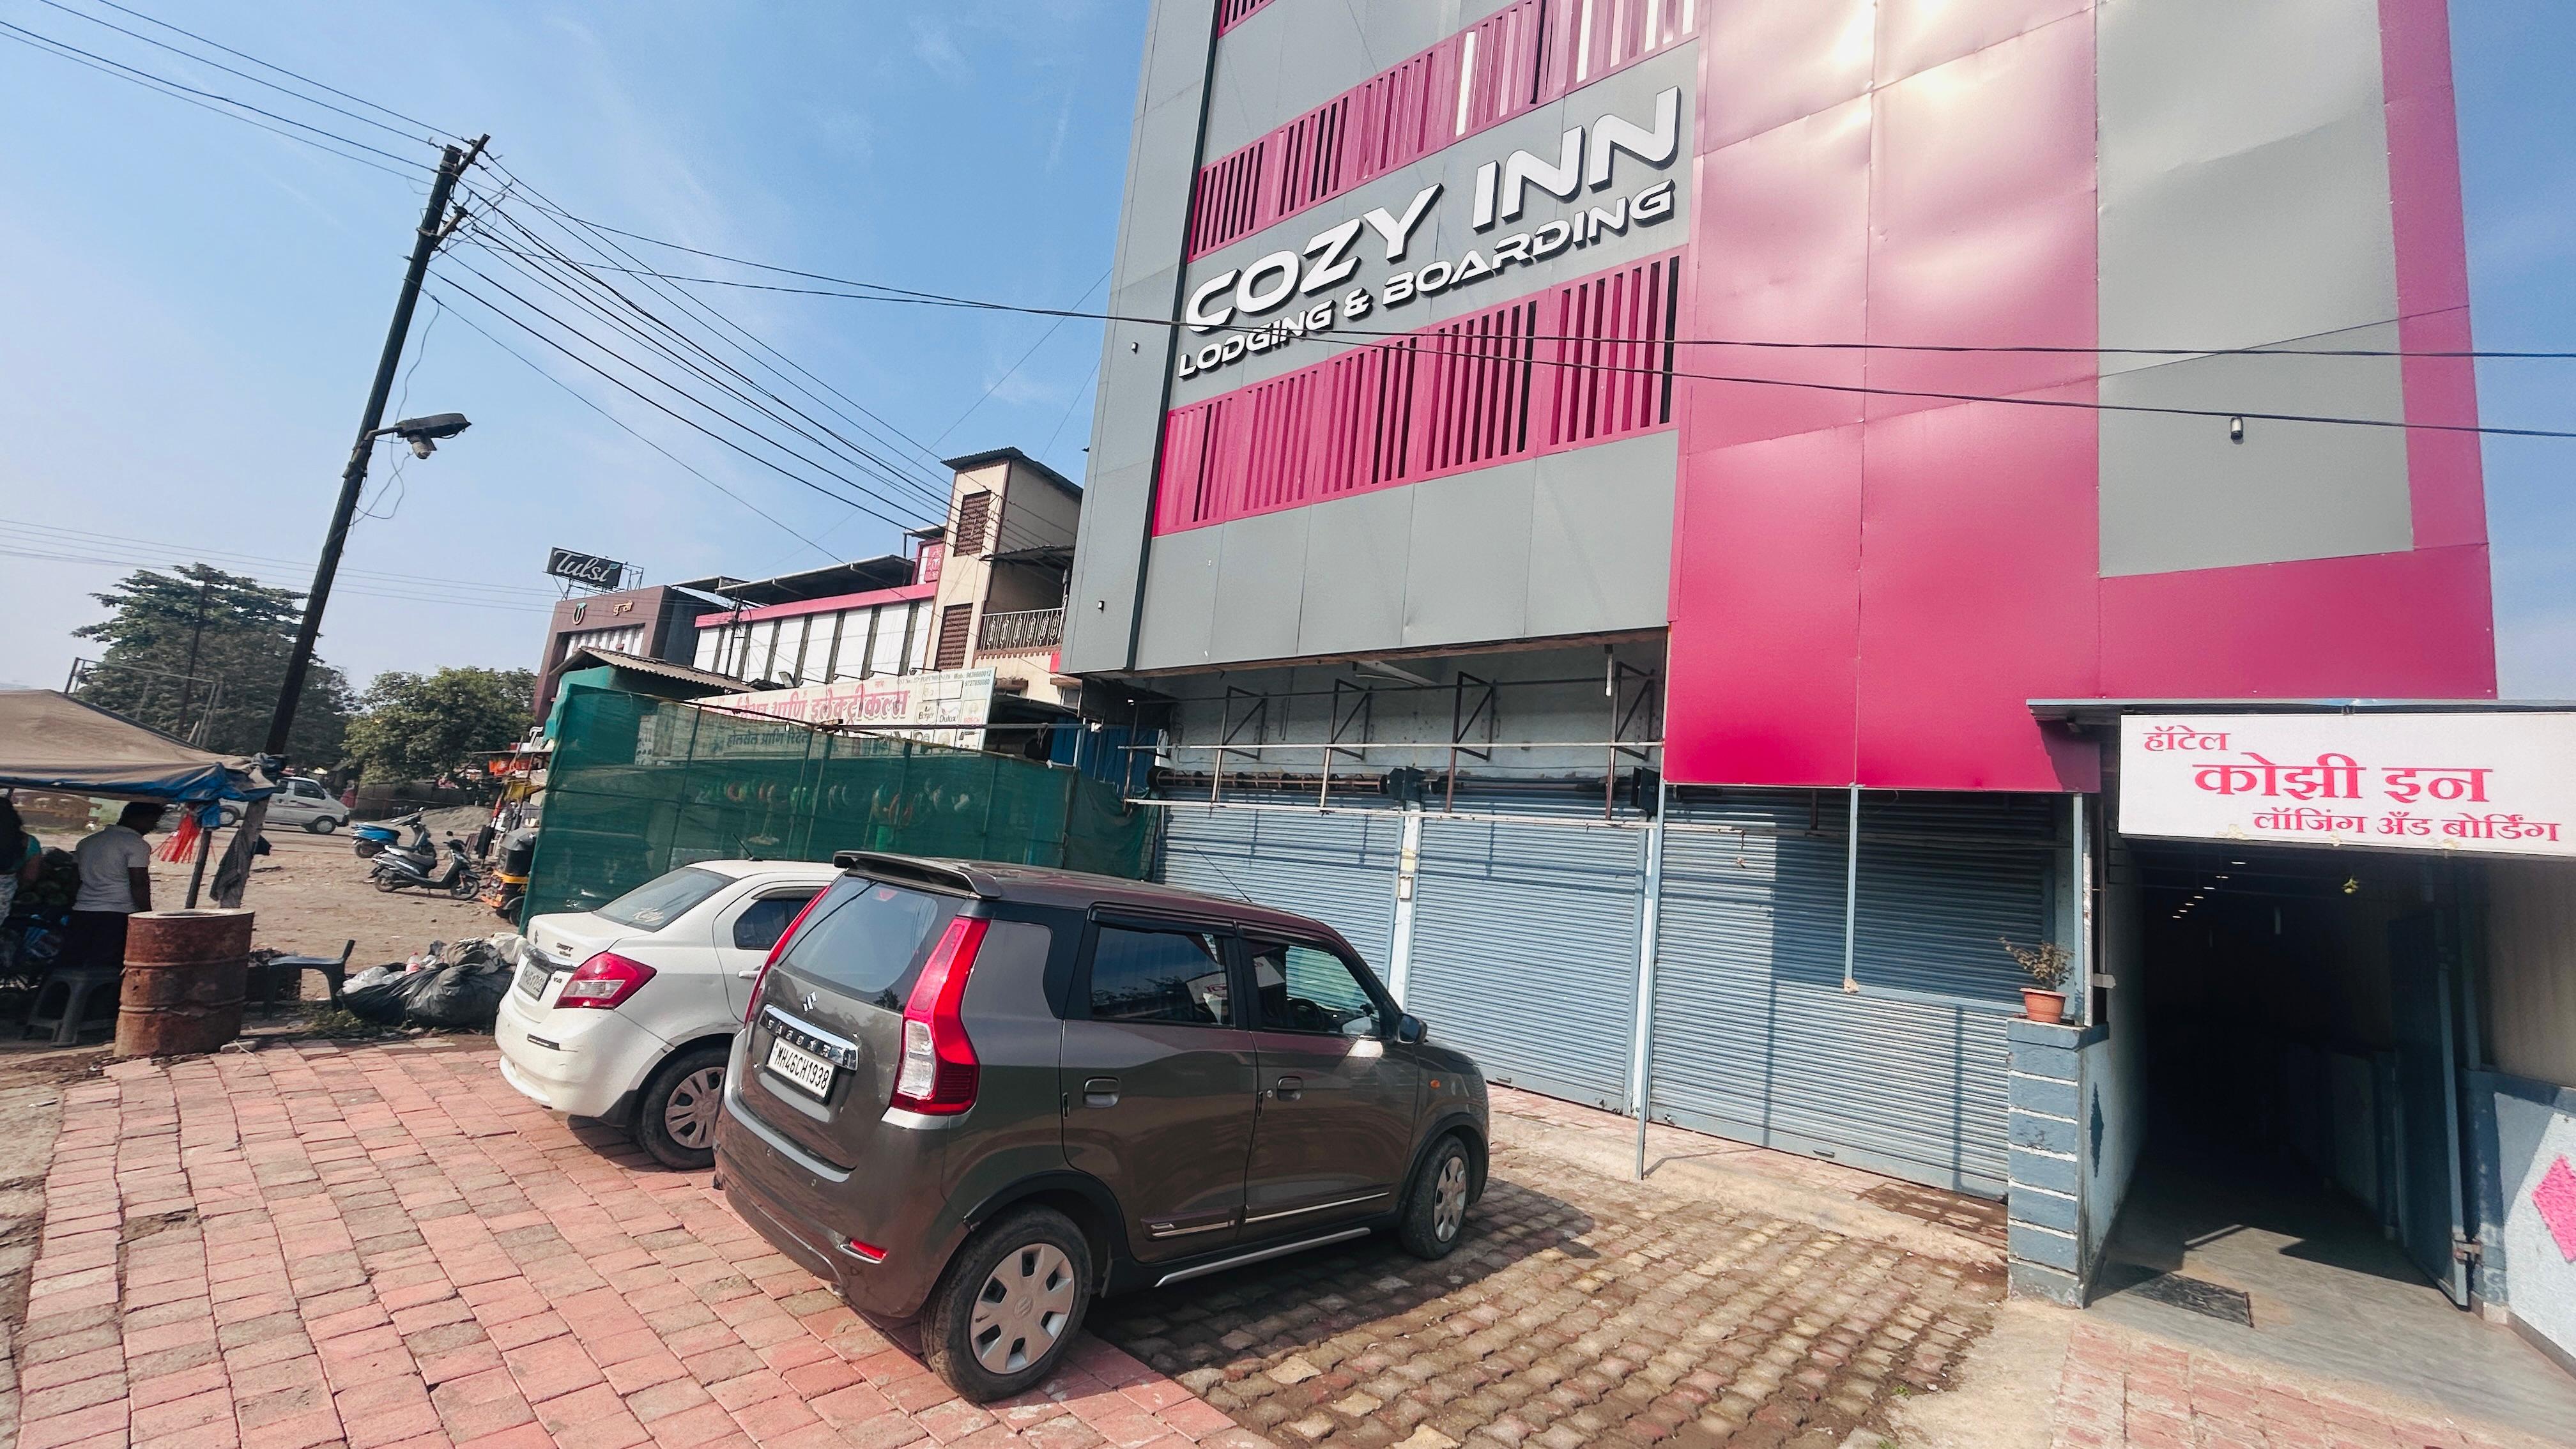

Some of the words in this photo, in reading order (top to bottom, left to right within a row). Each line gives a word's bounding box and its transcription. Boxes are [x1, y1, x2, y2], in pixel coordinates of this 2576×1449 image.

[1184, 183, 1443, 334] COZY
[1472, 86, 1680, 230] INN
[1178, 300, 1335, 378] LODGING
[1342, 288, 1372, 318] &
[1382, 179, 1675, 308] BOARDING
[553, 549, 620, 582] Tulsi
[2143, 725, 2230, 751] हॉटेल
[2192, 752, 2366, 800] कोझी
[2381, 766, 2494, 803] इन
[2253, 807, 2368, 833] लॉजिंग
[2377, 813, 2433, 836] अँड
[2441, 814, 2561, 842] बोर्डिंग
[775, 1048, 829, 1090] MH46CH1938
